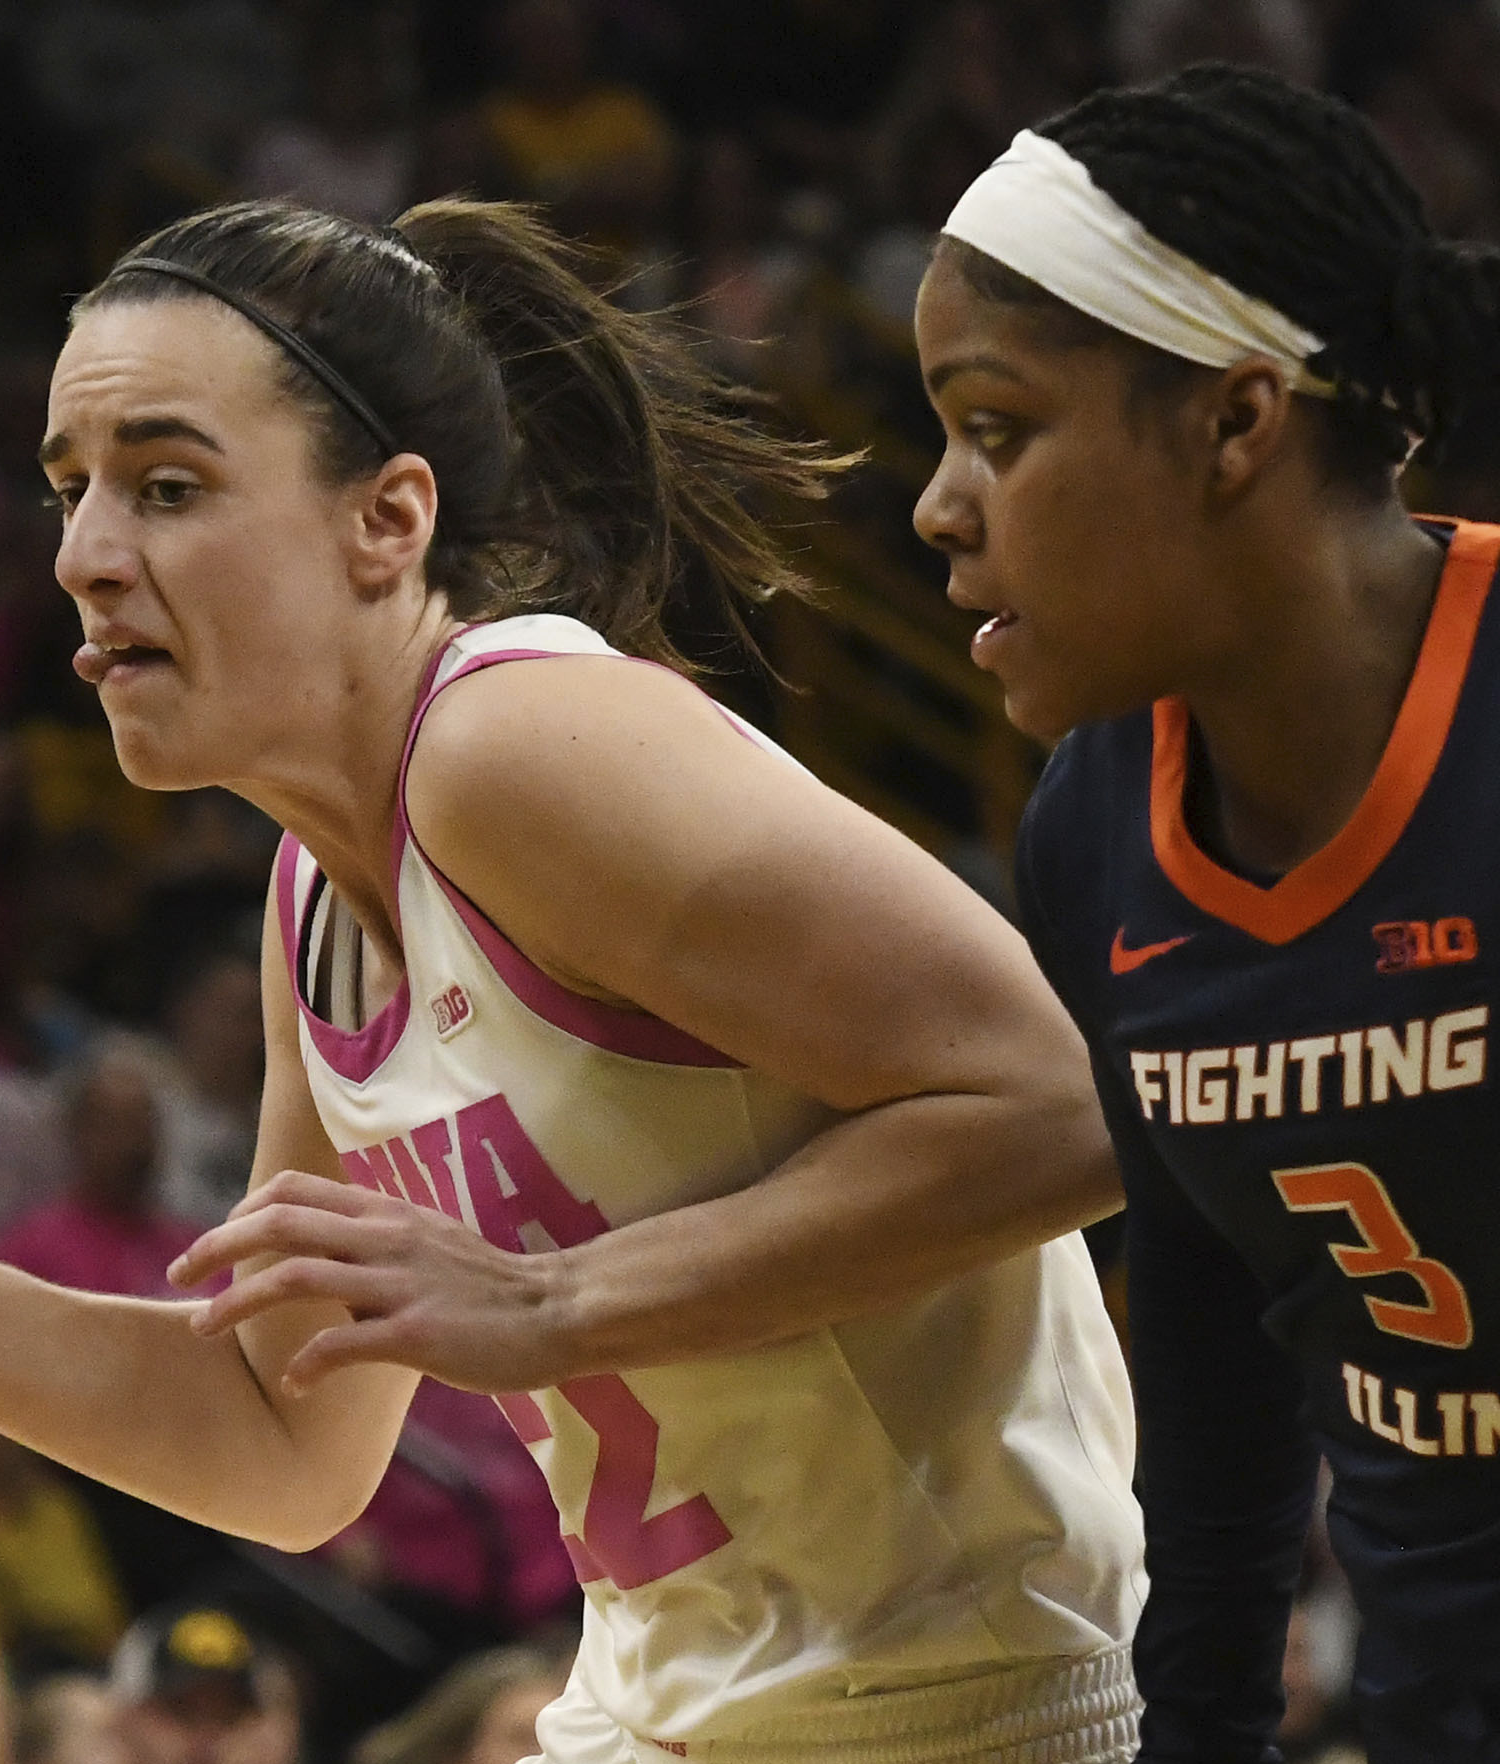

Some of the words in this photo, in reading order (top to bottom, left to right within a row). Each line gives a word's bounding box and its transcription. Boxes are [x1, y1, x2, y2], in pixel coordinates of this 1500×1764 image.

[1129, 1003, 1490, 1126] FIGHTING
[1270, 1161, 1475, 1350] 3
[496, 1372, 734, 1591] 2
